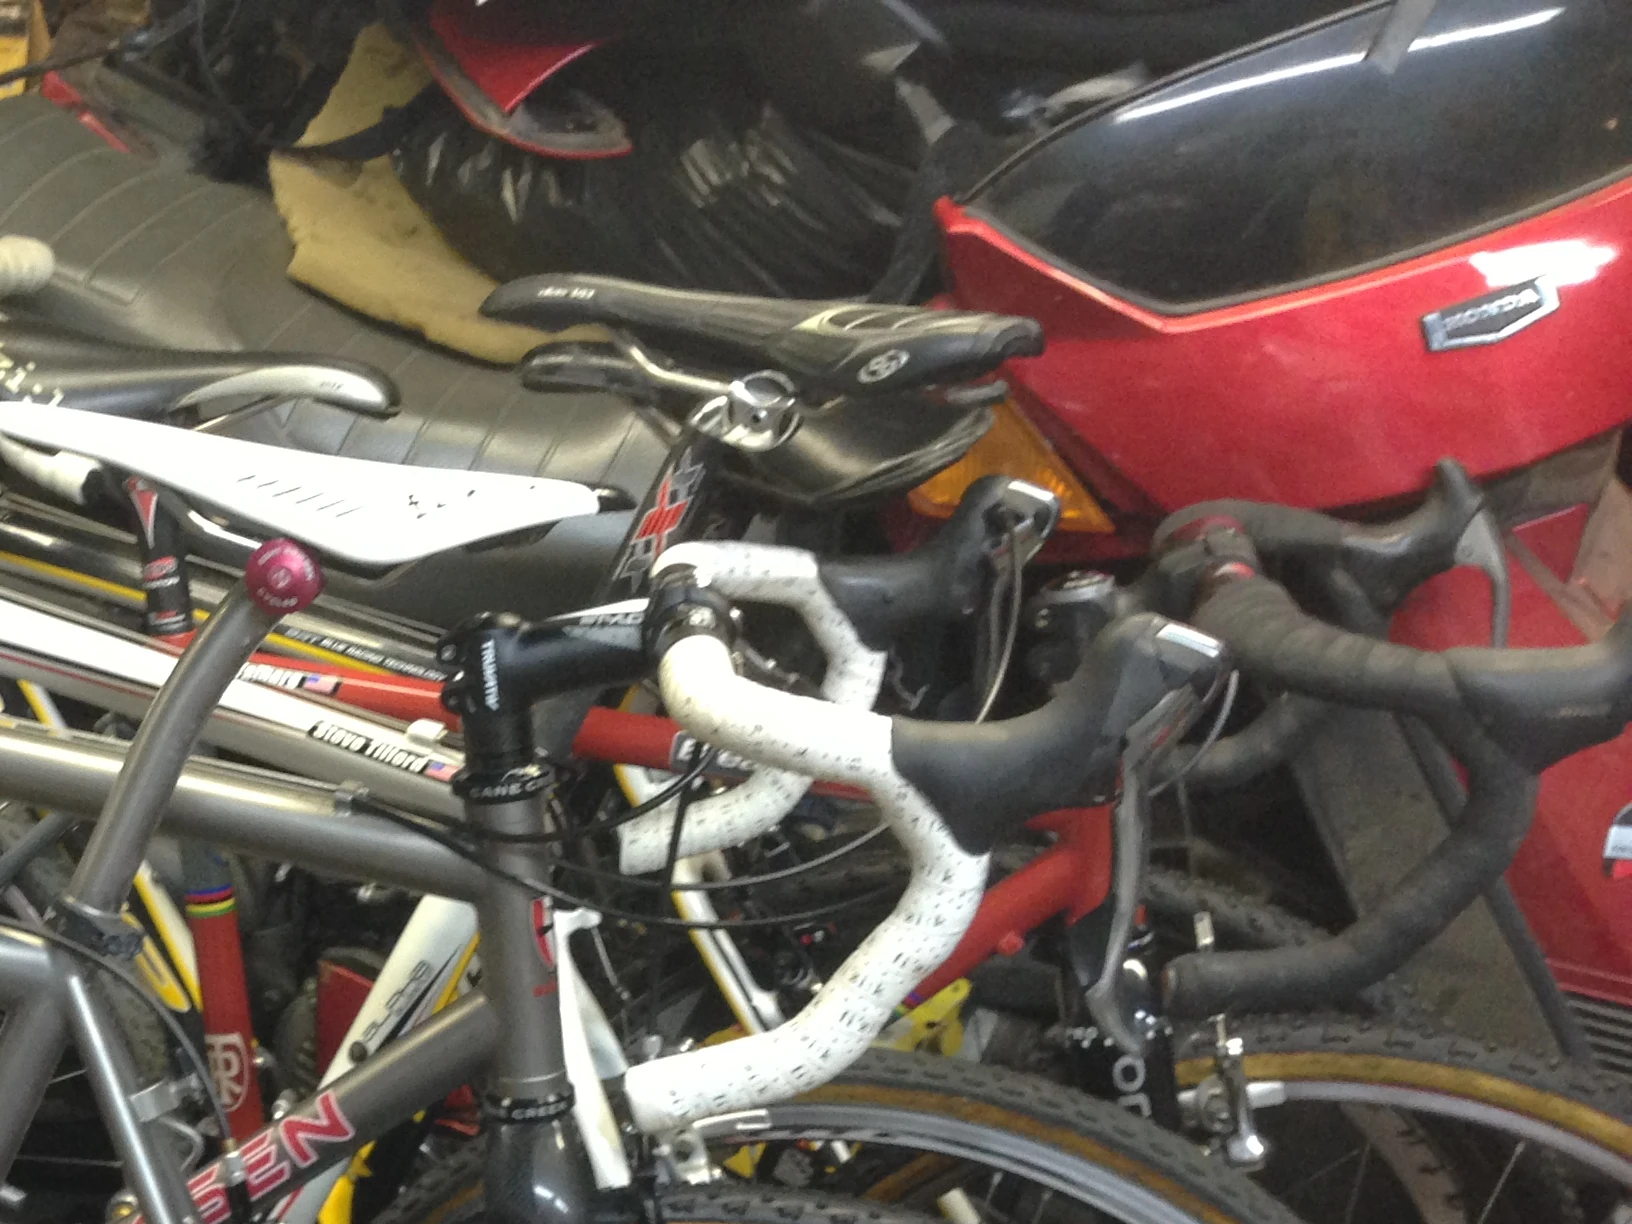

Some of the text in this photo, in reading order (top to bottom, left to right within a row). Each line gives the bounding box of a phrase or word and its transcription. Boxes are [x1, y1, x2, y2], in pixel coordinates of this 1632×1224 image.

[1443, 288, 1541, 332] HONDA
[313, 721, 429, 774] Steve Tilford
